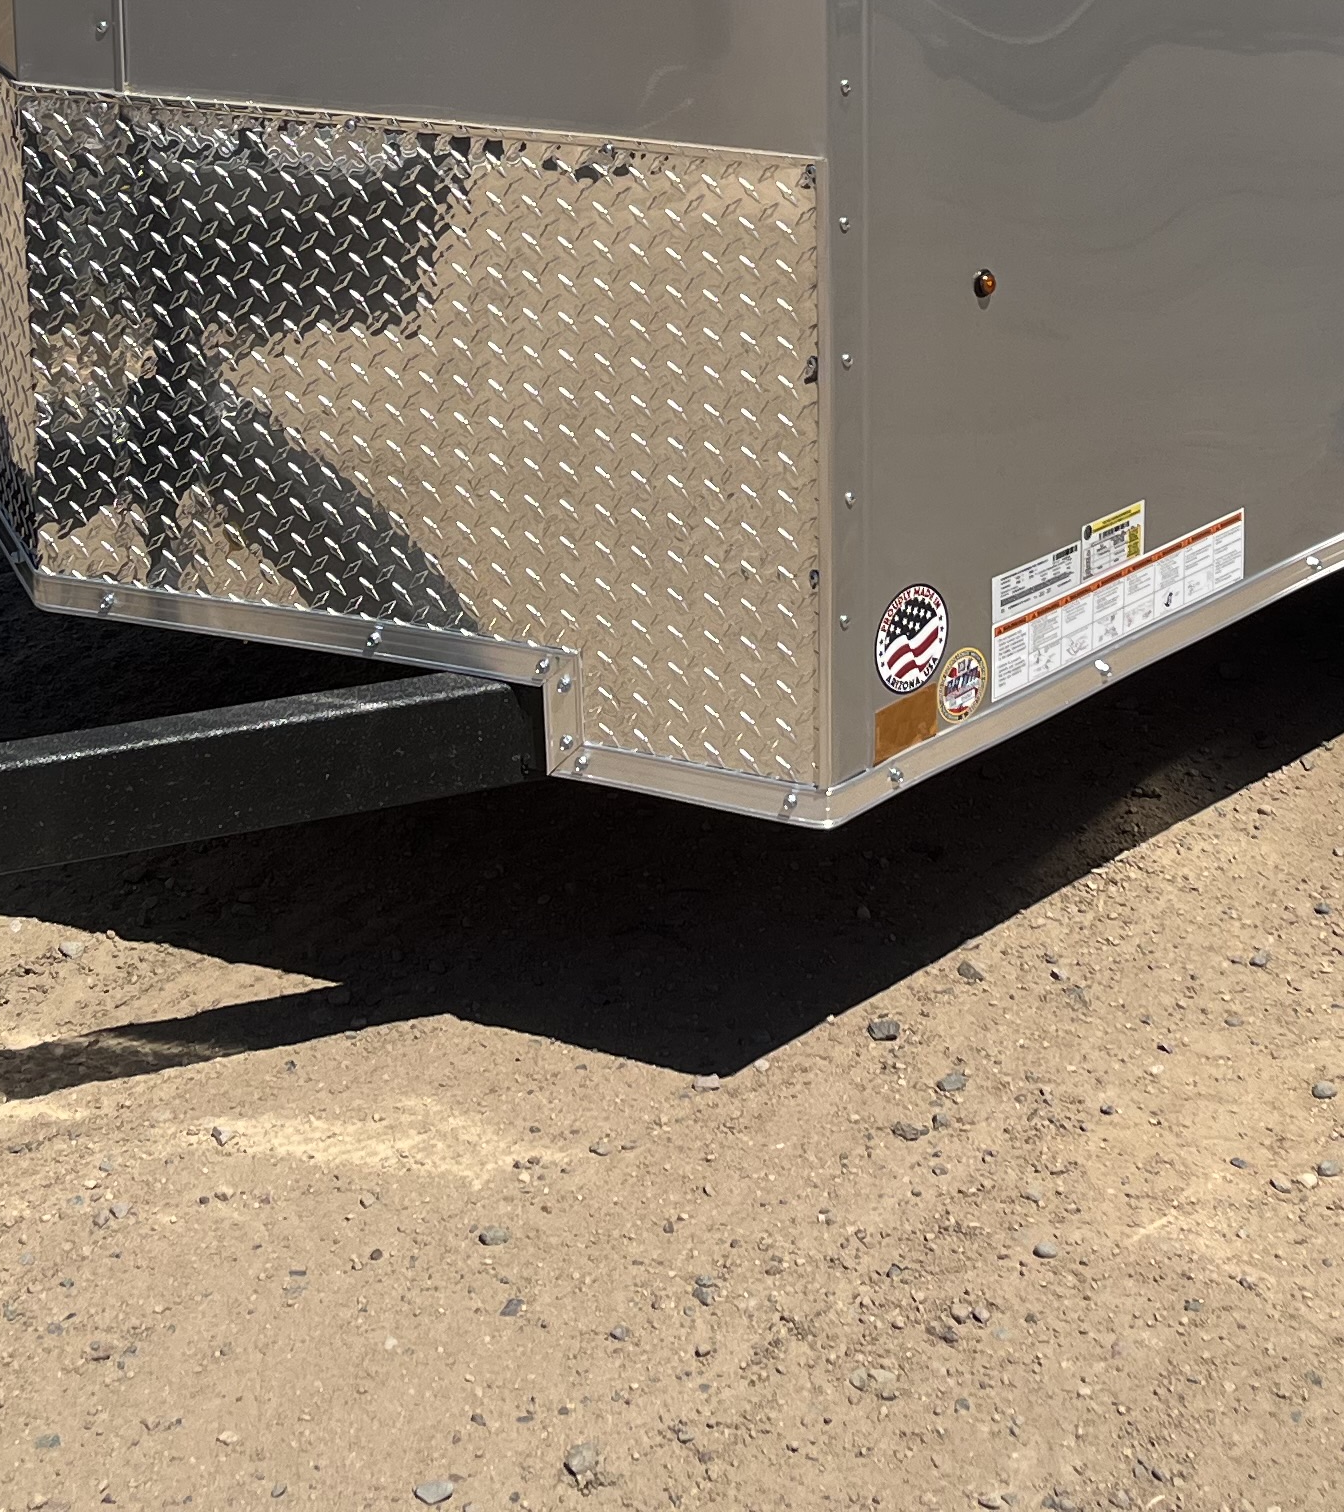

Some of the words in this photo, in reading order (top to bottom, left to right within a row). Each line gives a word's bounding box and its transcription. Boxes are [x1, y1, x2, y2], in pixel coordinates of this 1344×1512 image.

[881, 590, 911, 632] PROUDLY
[914, 587, 935, 601] MADE
[923, 657, 938, 677] USA
